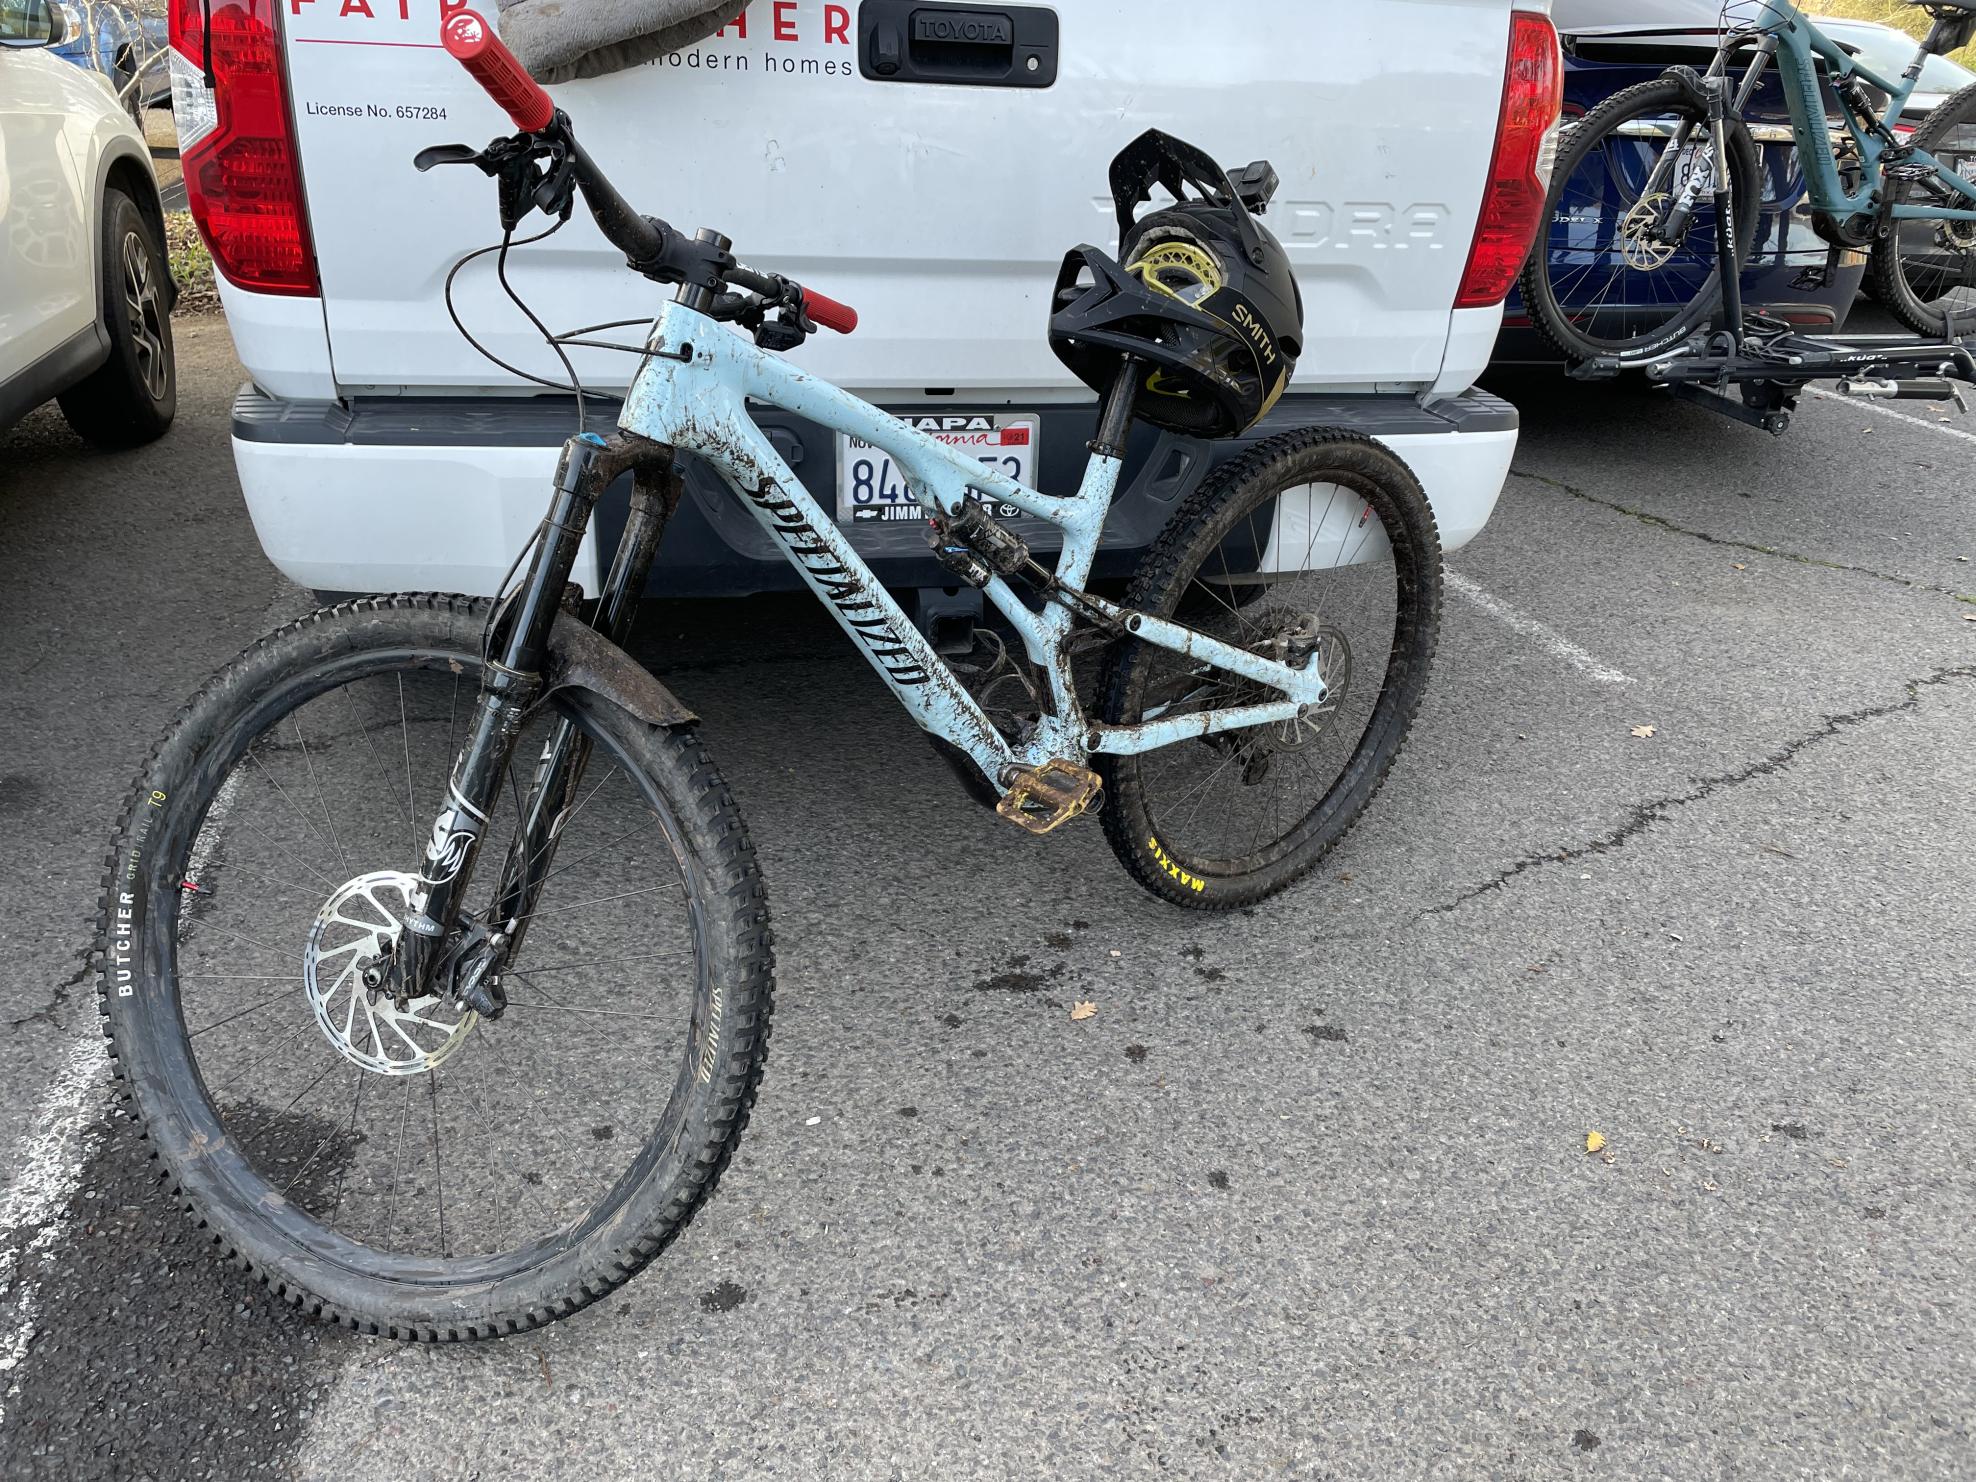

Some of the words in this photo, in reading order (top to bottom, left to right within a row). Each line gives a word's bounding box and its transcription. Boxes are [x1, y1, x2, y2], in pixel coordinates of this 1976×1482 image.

[920, 20, 1006, 42] TOYOTA
[765, 52, 852, 76] homes
[306, 101, 363, 117] License
[367, 104, 392, 118] No.
[396, 105, 448, 120] 657284
[1231, 304, 1276, 365] SMITH
[1644, 325, 1687, 353] BUTCHER
[881, 505, 929, 521] JIMM
[734, 475, 931, 686] SPECIALIZED
[1148, 836, 1206, 892] MAXXIS
[117, 892, 135, 997] BUTCHER
[126, 849, 141, 880] GRID
[148, 790, 167, 808] T9
[404, 912, 436, 932] HYTHM
